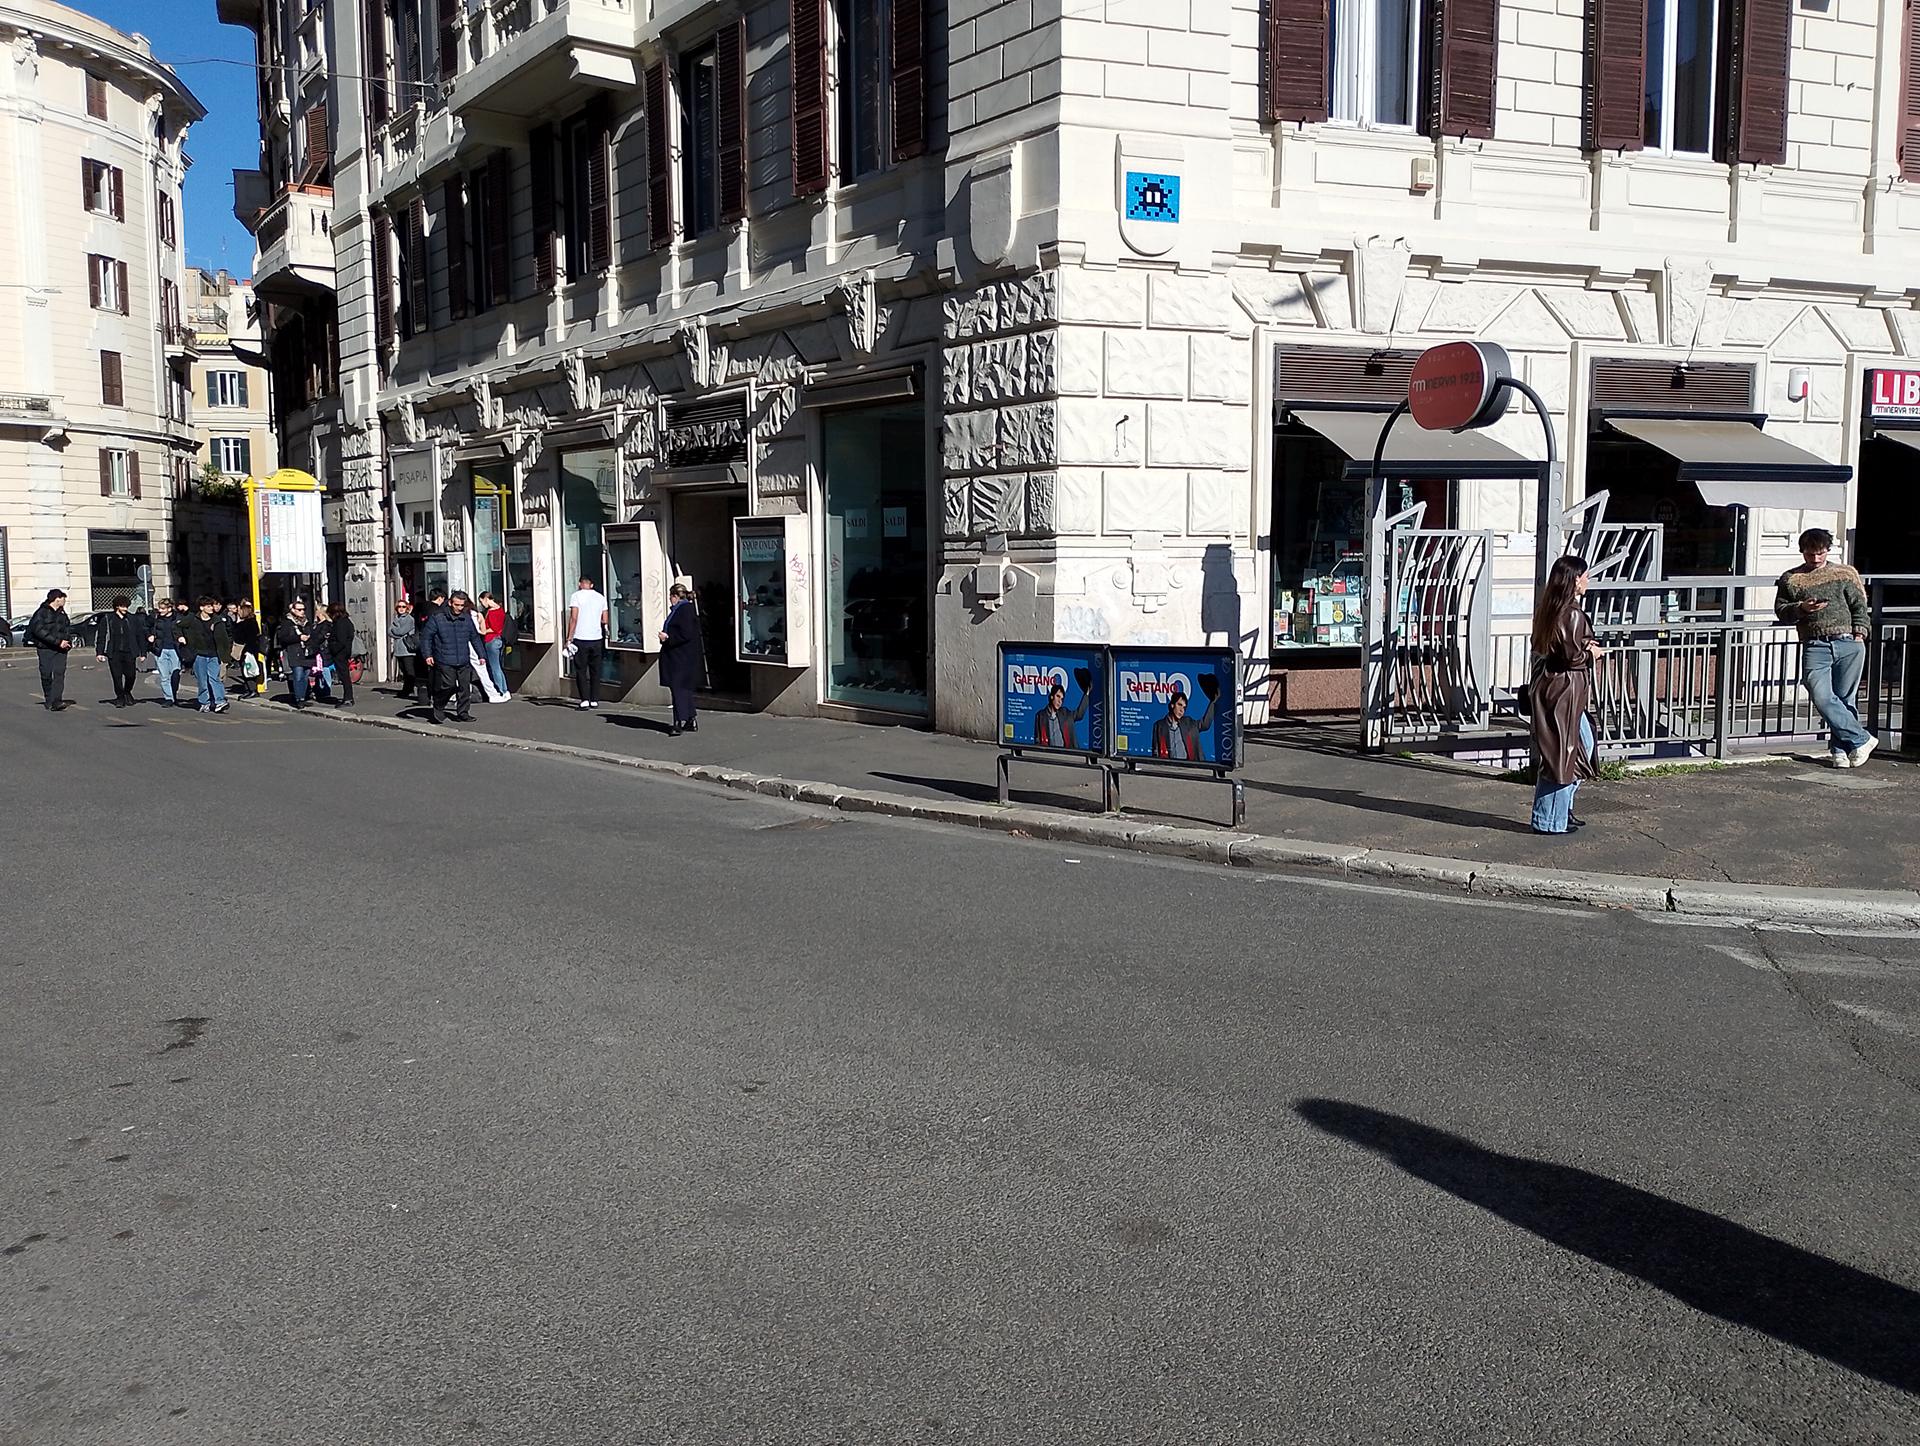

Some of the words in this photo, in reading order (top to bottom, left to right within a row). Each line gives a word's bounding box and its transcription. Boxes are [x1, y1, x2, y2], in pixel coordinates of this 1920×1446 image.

[1413, 375, 1457, 392] MINERVA
[1875, 373, 1920, 404] LIB
[399, 470, 428, 485] PISAPIA
[846, 517, 866, 528] SALDI
[884, 516, 905, 527] SALDI
[1008, 664, 1068, 696] RINO
[1015, 674, 1057, 687] GAETANO
[1120, 671, 1192, 704] RINO
[1128, 681, 1179, 694] GAETANO
[1093, 701, 1102, 749] ROMA
[1221, 710, 1233, 761] ROMA
